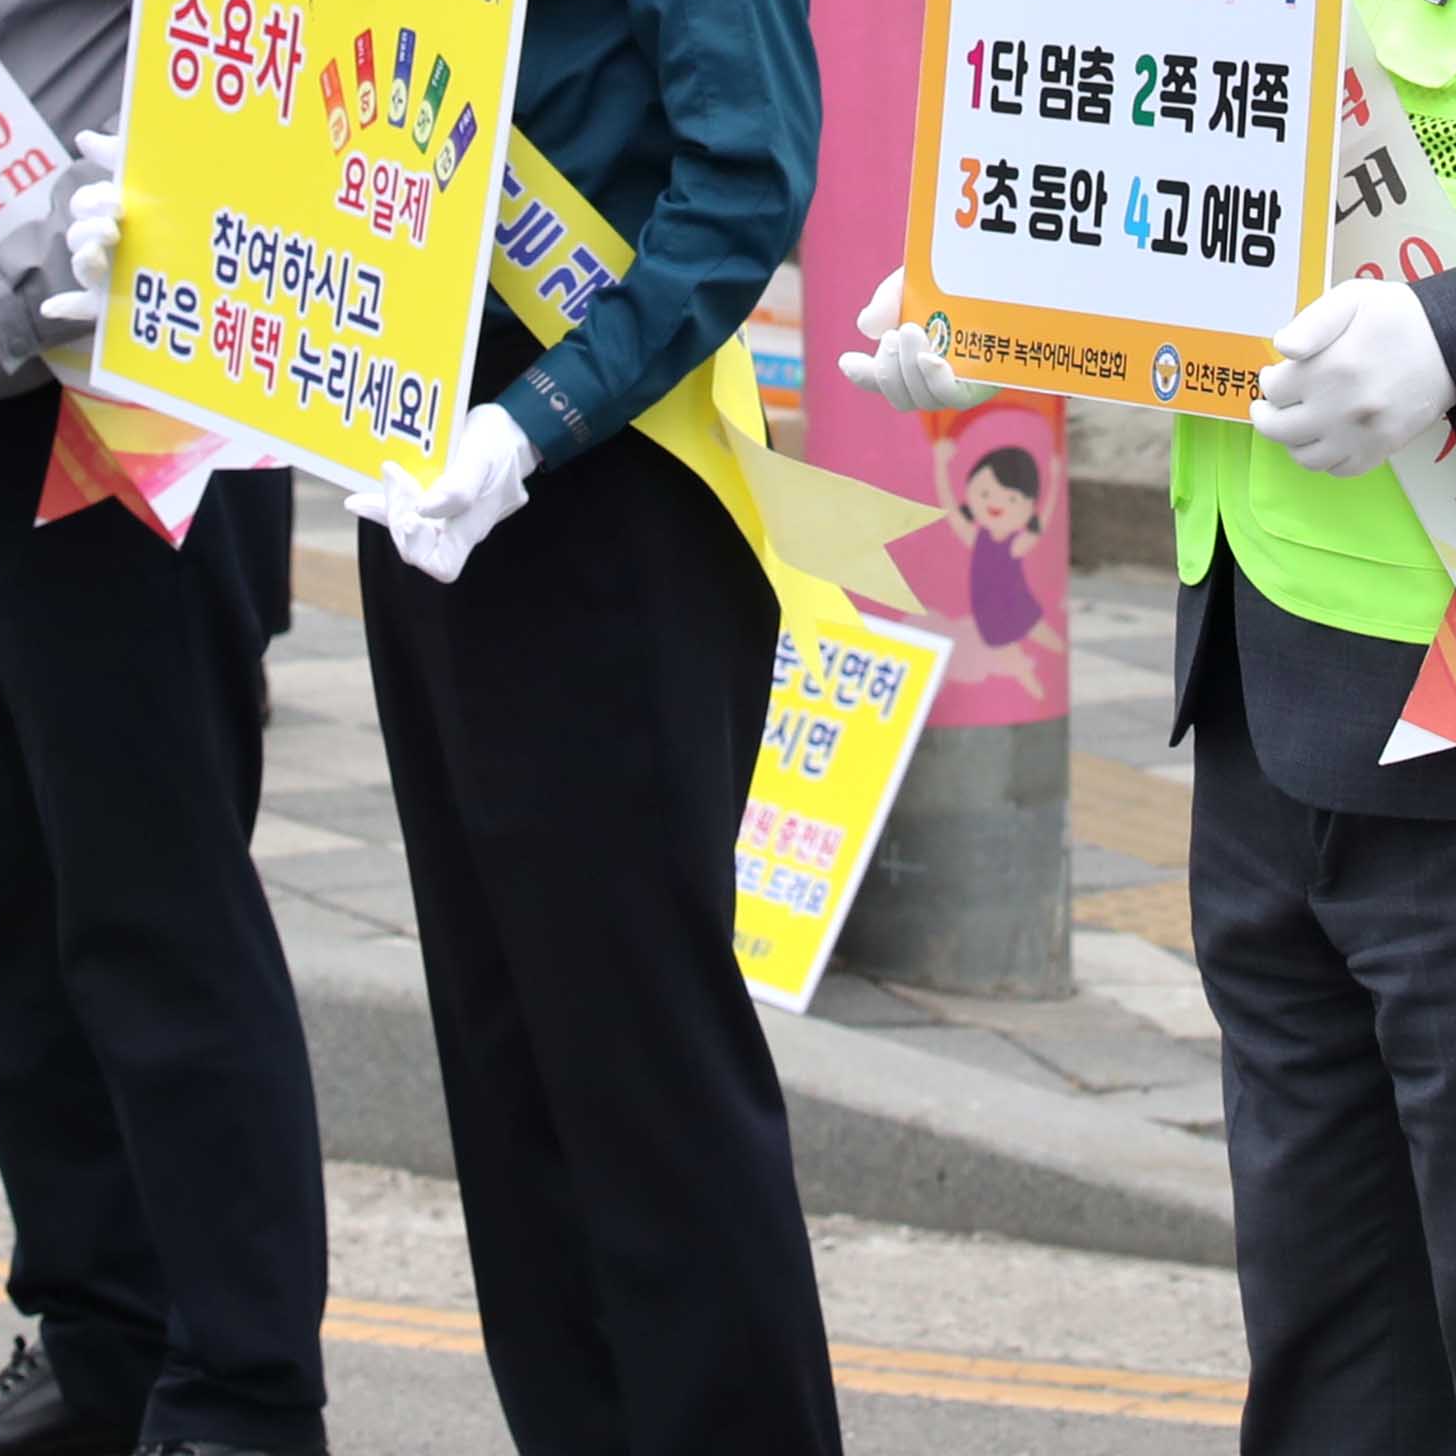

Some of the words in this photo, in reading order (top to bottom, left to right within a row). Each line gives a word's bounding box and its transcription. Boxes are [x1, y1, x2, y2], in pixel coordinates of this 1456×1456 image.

[967, 39, 1027, 115] 1단
[1039, 44, 1115, 125] 멈춤
[1131, 53, 1198, 134] 2쪽
[1209, 61, 1290, 143] 저쪽
[336, 155, 432, 243] 요일제
[955, 158, 1020, 235] 3초
[1029, 163, 1108, 247] 동안
[1123, 175, 1191, 257] 4고
[1200, 183, 1282, 268] 예방
[211, 212, 383, 333] 참여하시고
[132, 272, 201, 357] 많은
[210, 299, 284, 390] 혜택
[290, 335, 440, 451] 누리세요!
[954, 329, 1011, 365] 인천중부
[1014, 342, 1128, 382] 녹색어머니연합회
[1185, 361, 1267, 402] 인천중부경
[765, 702, 838, 775] 시면
